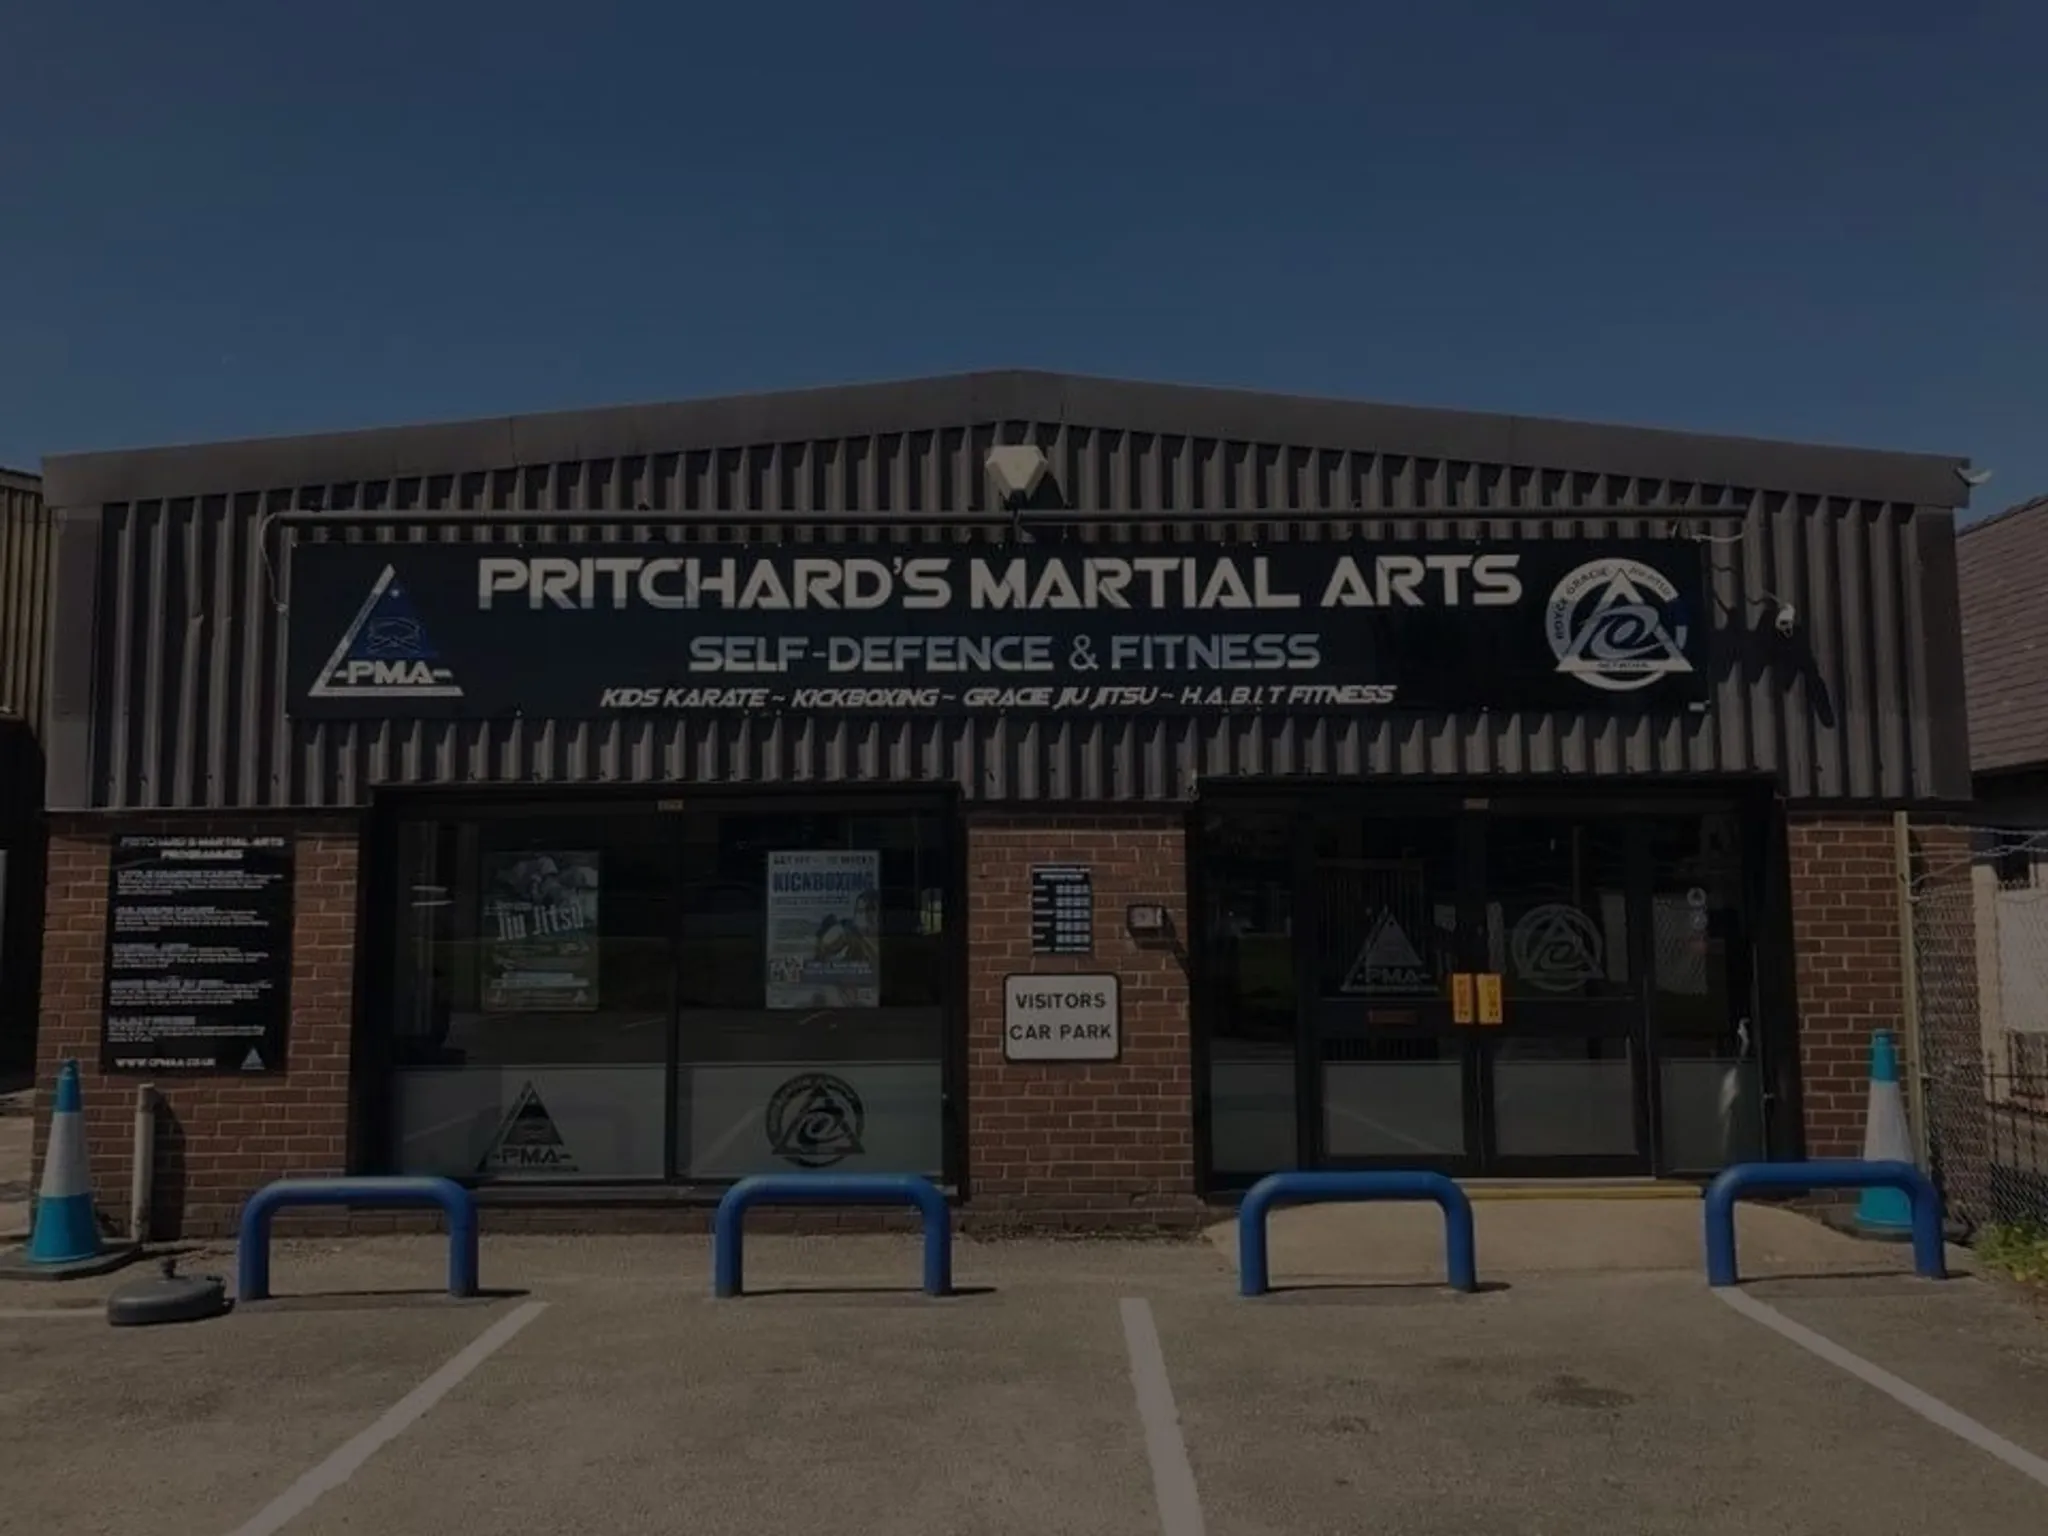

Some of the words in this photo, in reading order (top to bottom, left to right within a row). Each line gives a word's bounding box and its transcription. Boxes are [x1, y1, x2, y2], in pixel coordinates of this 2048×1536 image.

[478, 557, 952, 610] PRITCHARD'S
[970, 556, 1302, 609] MARTIAL
[1320, 553, 1524, 608] ARTS
[688, 635, 1054, 673] SELF-DEFENCE
[1067, 634, 1098, 673] &
[1110, 632, 1321, 671] FITNESS
[601, 688, 662, 708] KIDS
[663, 688, 769, 708] KARATE
[791, 687, 940, 708] KICKBOXING
[963, 687, 1052, 707] GRACIE
[1052, 687, 1088, 711] JIU
[1089, 687, 1159, 709] JITSU
[1288, 684, 1397, 705] FITNESS
[1015, 993, 1107, 1009] VISITORS
[1009, 1024, 1051, 1040] CAR
[1060, 1023, 1111, 1040] PARK
